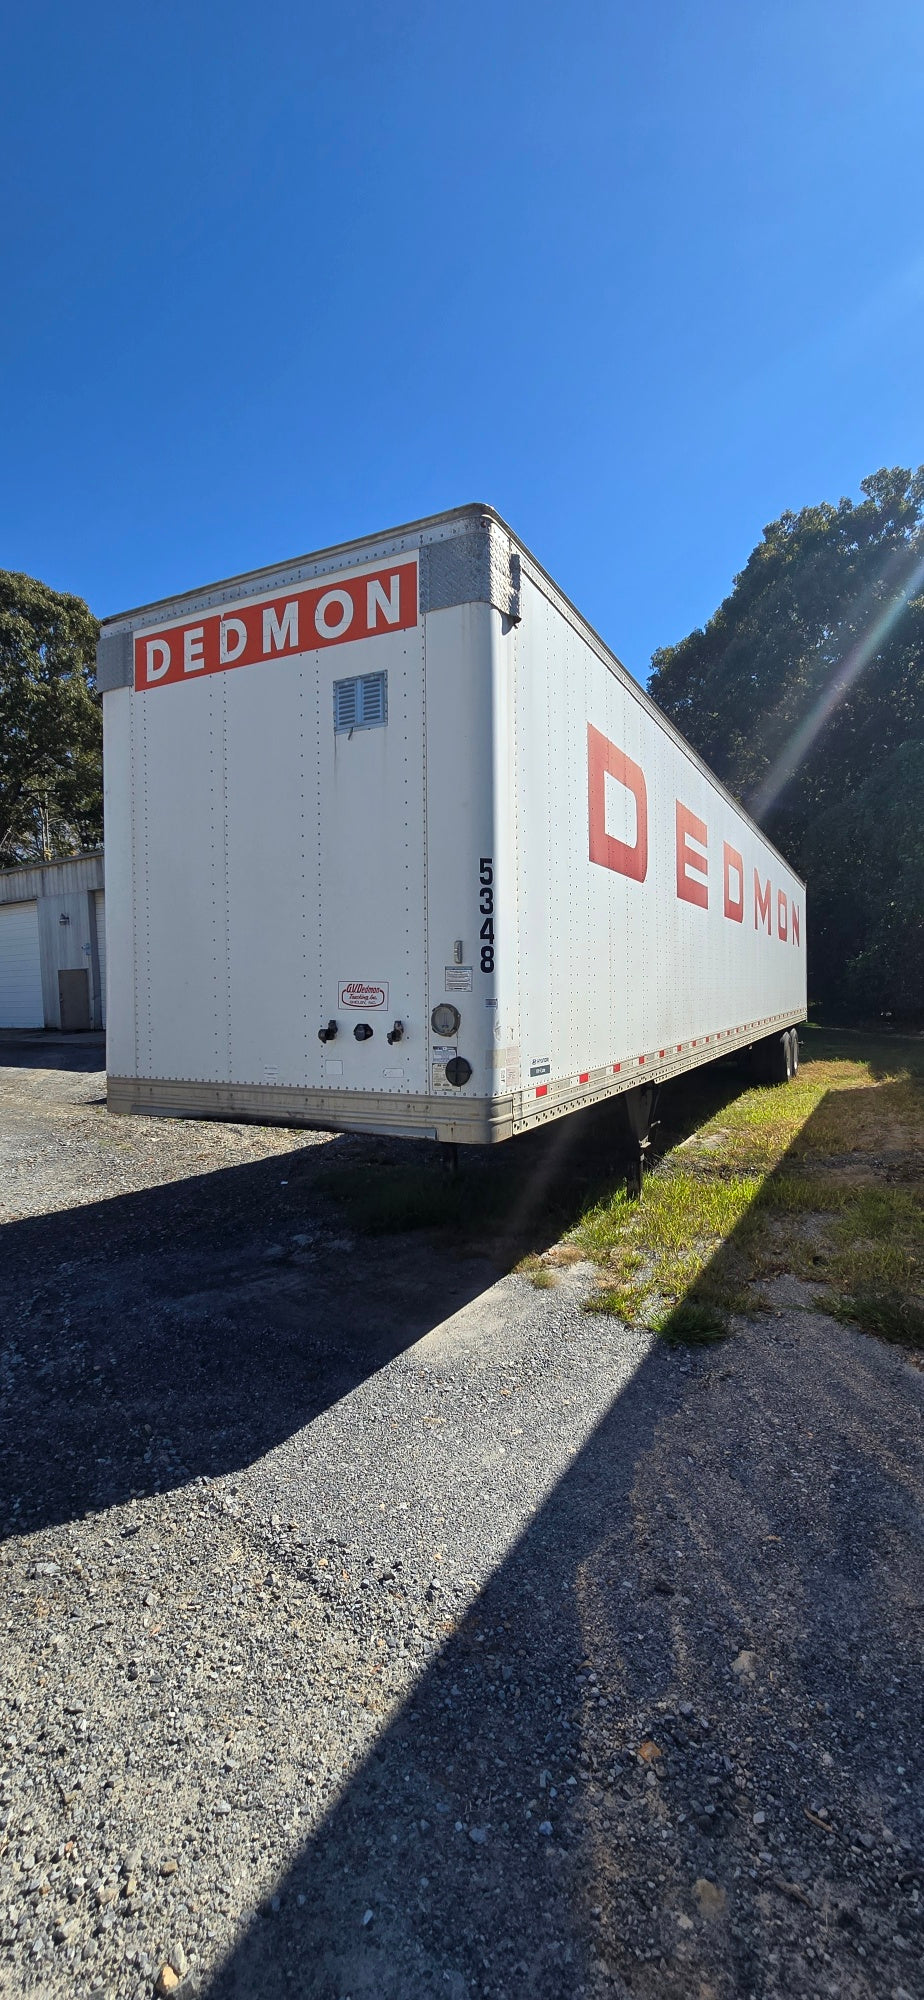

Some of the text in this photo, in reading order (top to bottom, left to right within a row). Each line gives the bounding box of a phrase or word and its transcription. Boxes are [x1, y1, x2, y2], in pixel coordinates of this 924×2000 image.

[146, 574, 400, 682] DEDMON
[587, 720, 800, 948] DEDMON
[479, 858, 495, 974] 5348
